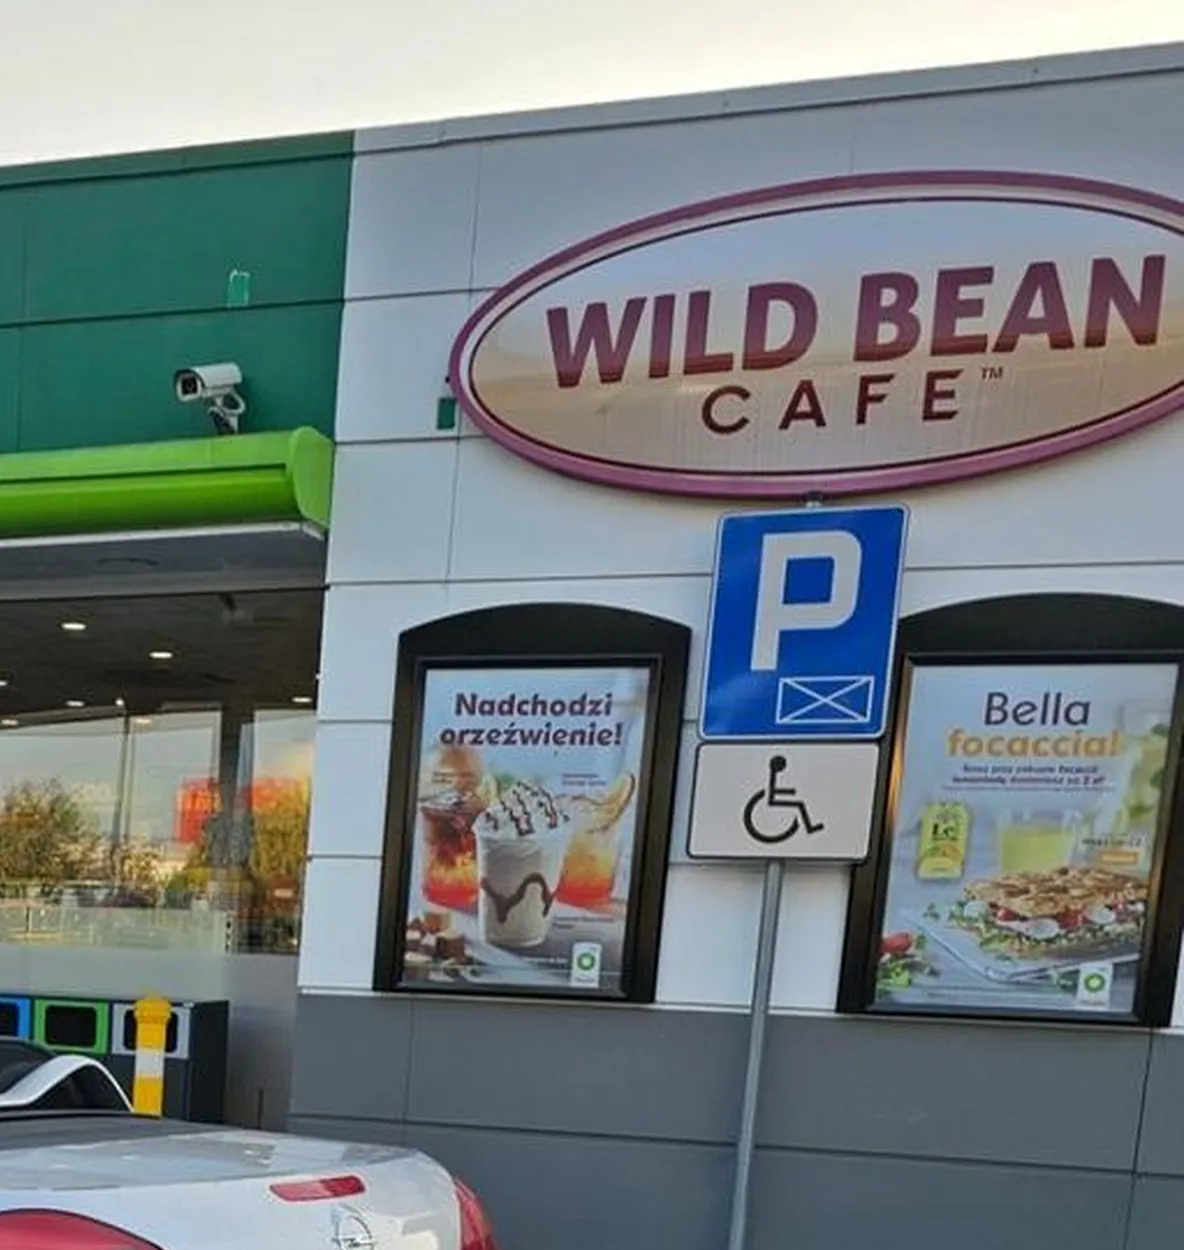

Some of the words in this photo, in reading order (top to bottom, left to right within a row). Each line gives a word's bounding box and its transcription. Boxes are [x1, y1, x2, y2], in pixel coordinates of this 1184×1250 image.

[545, 281, 818, 388] WILD
[852, 254, 1166, 363] BEAN
[701, 367, 965, 435] CAFE
[750, 529, 863, 672] P
[454, 692, 613, 717] Nadchodzi
[983, 691, 1092, 726] Bella
[439, 721, 624, 747] orzeźwienie!
[947, 727, 1125, 757] focaccia!
